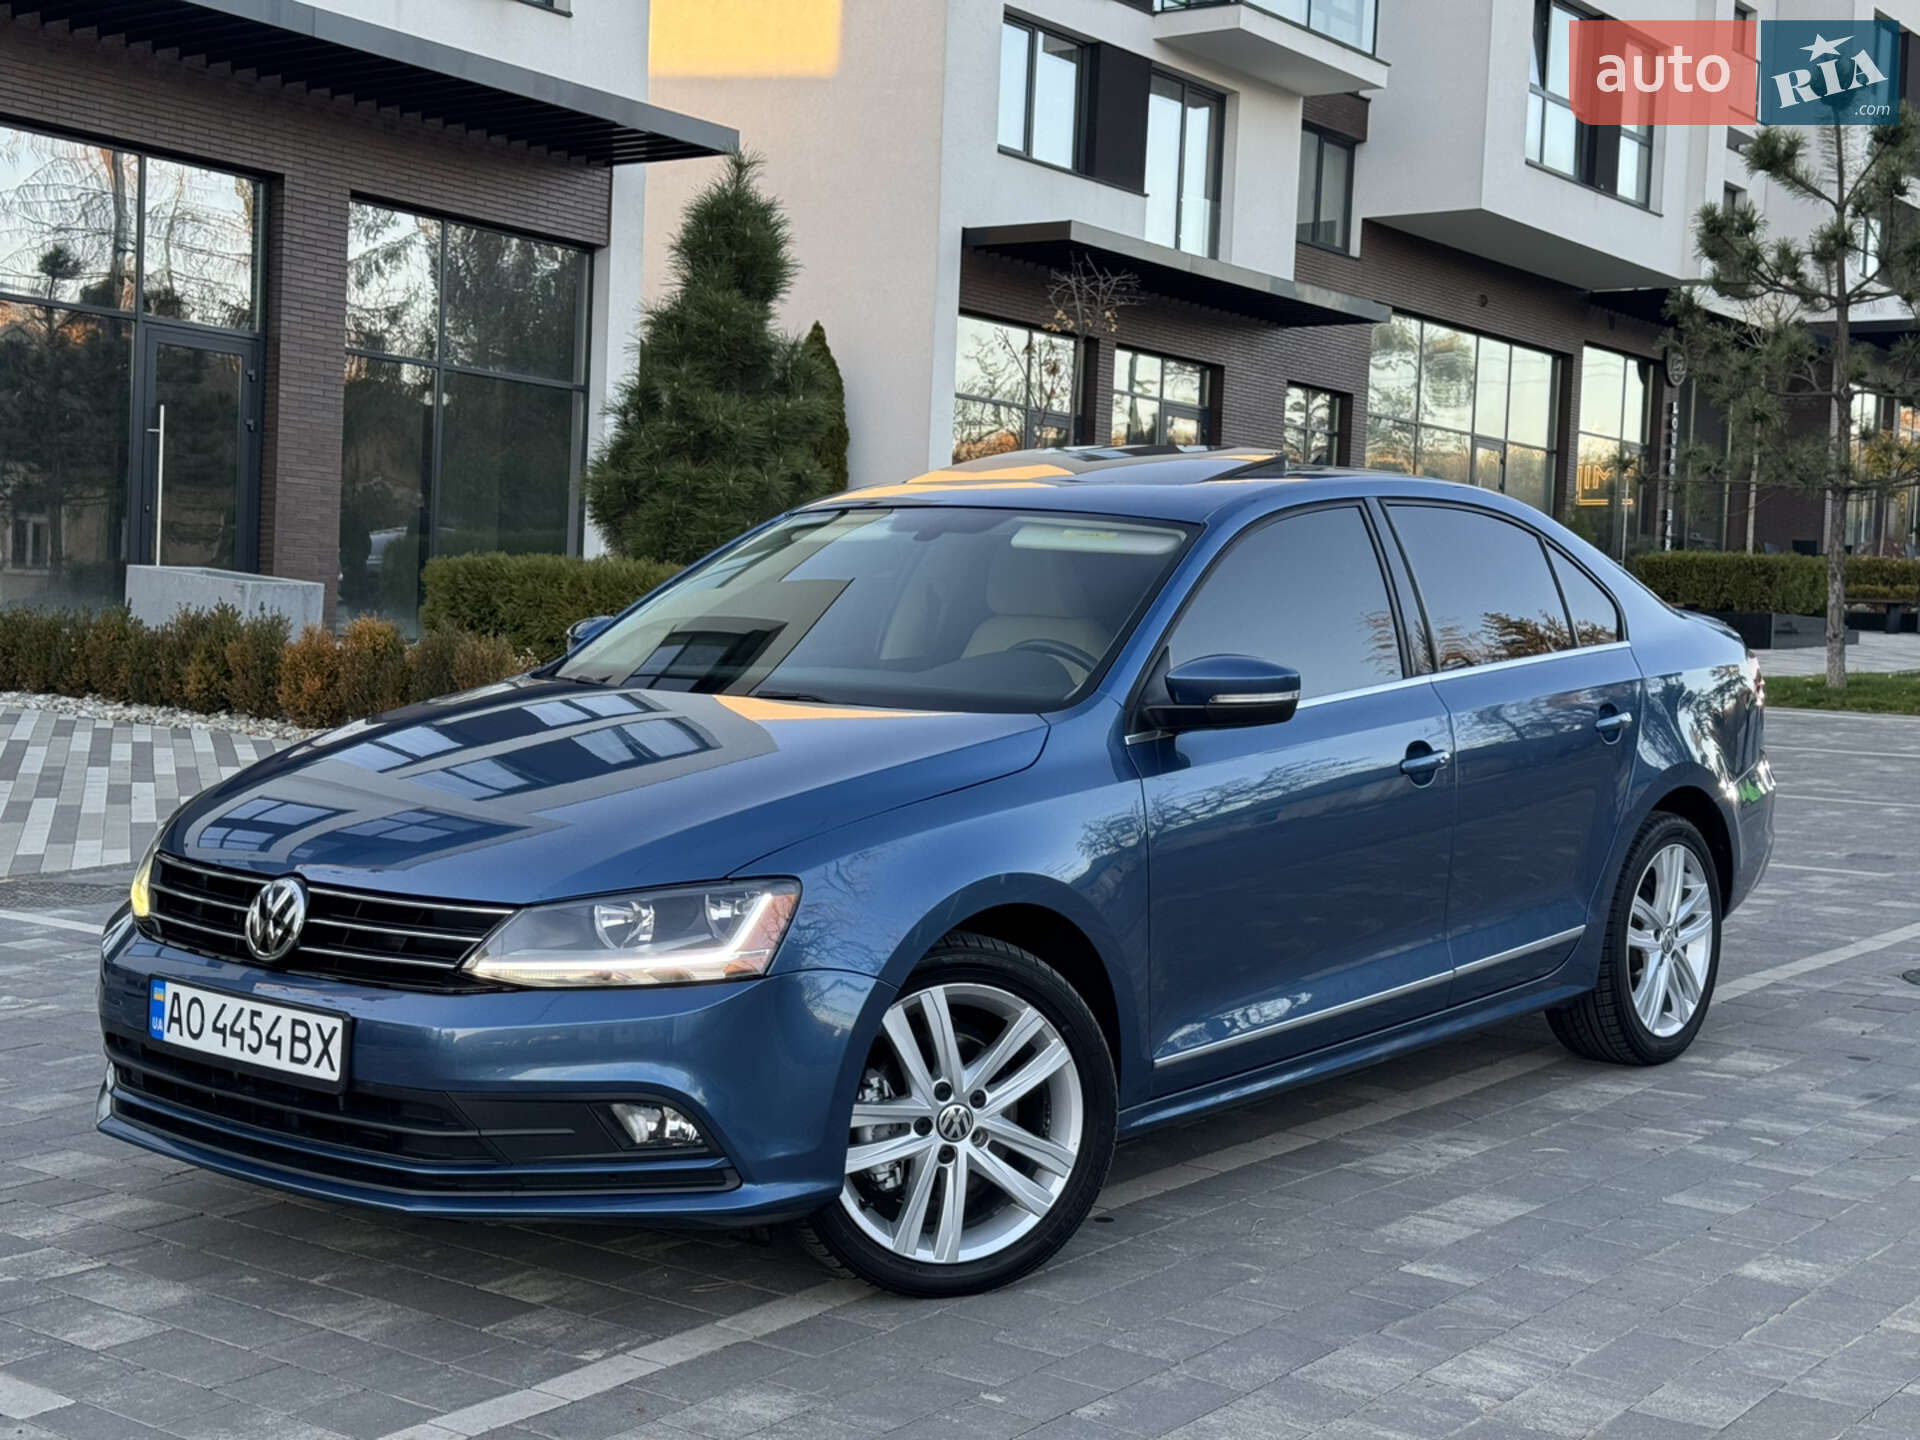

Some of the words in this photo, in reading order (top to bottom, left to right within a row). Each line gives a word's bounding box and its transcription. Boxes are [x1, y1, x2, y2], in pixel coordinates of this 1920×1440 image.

[1668, 401, 1679, 490] LOUNG
[152, 1016, 163, 1032] UA
[166, 991, 205, 1040] AO
[211, 1003, 282, 1060] 4454
[289, 1018, 339, 1073] BX
